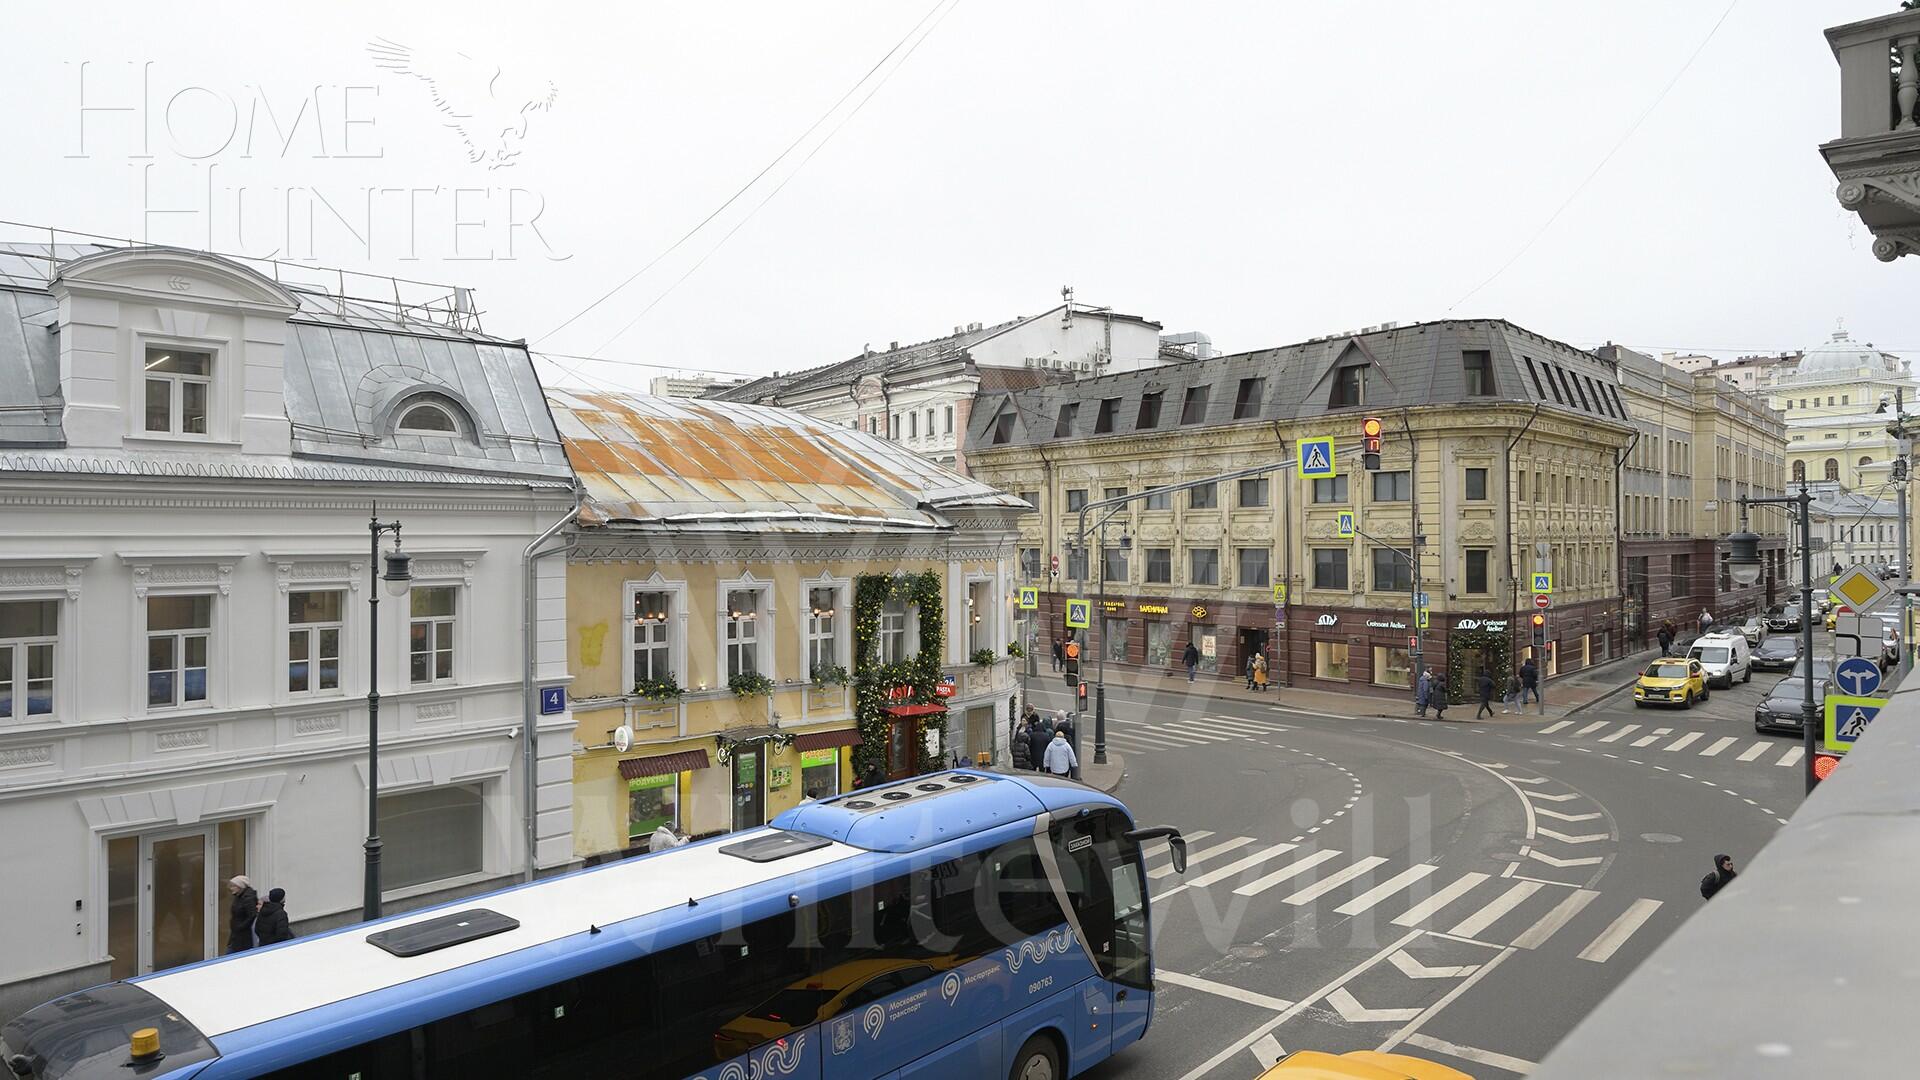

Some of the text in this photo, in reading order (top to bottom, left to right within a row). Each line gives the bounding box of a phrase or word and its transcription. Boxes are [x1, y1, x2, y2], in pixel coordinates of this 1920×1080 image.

[1366, 619, 1406, 629] Croissant Atelier
[1483, 618, 1508, 626] Croissant
[550, 692, 559, 704] 4
[883, 685, 915, 699] ASTA
[964, 965, 1001, 985] Мосгортранс
[1028, 976, 1053, 994] 090763
[889, 988, 928, 1012] Московский
[889, 1003, 922, 1022] транспорт
